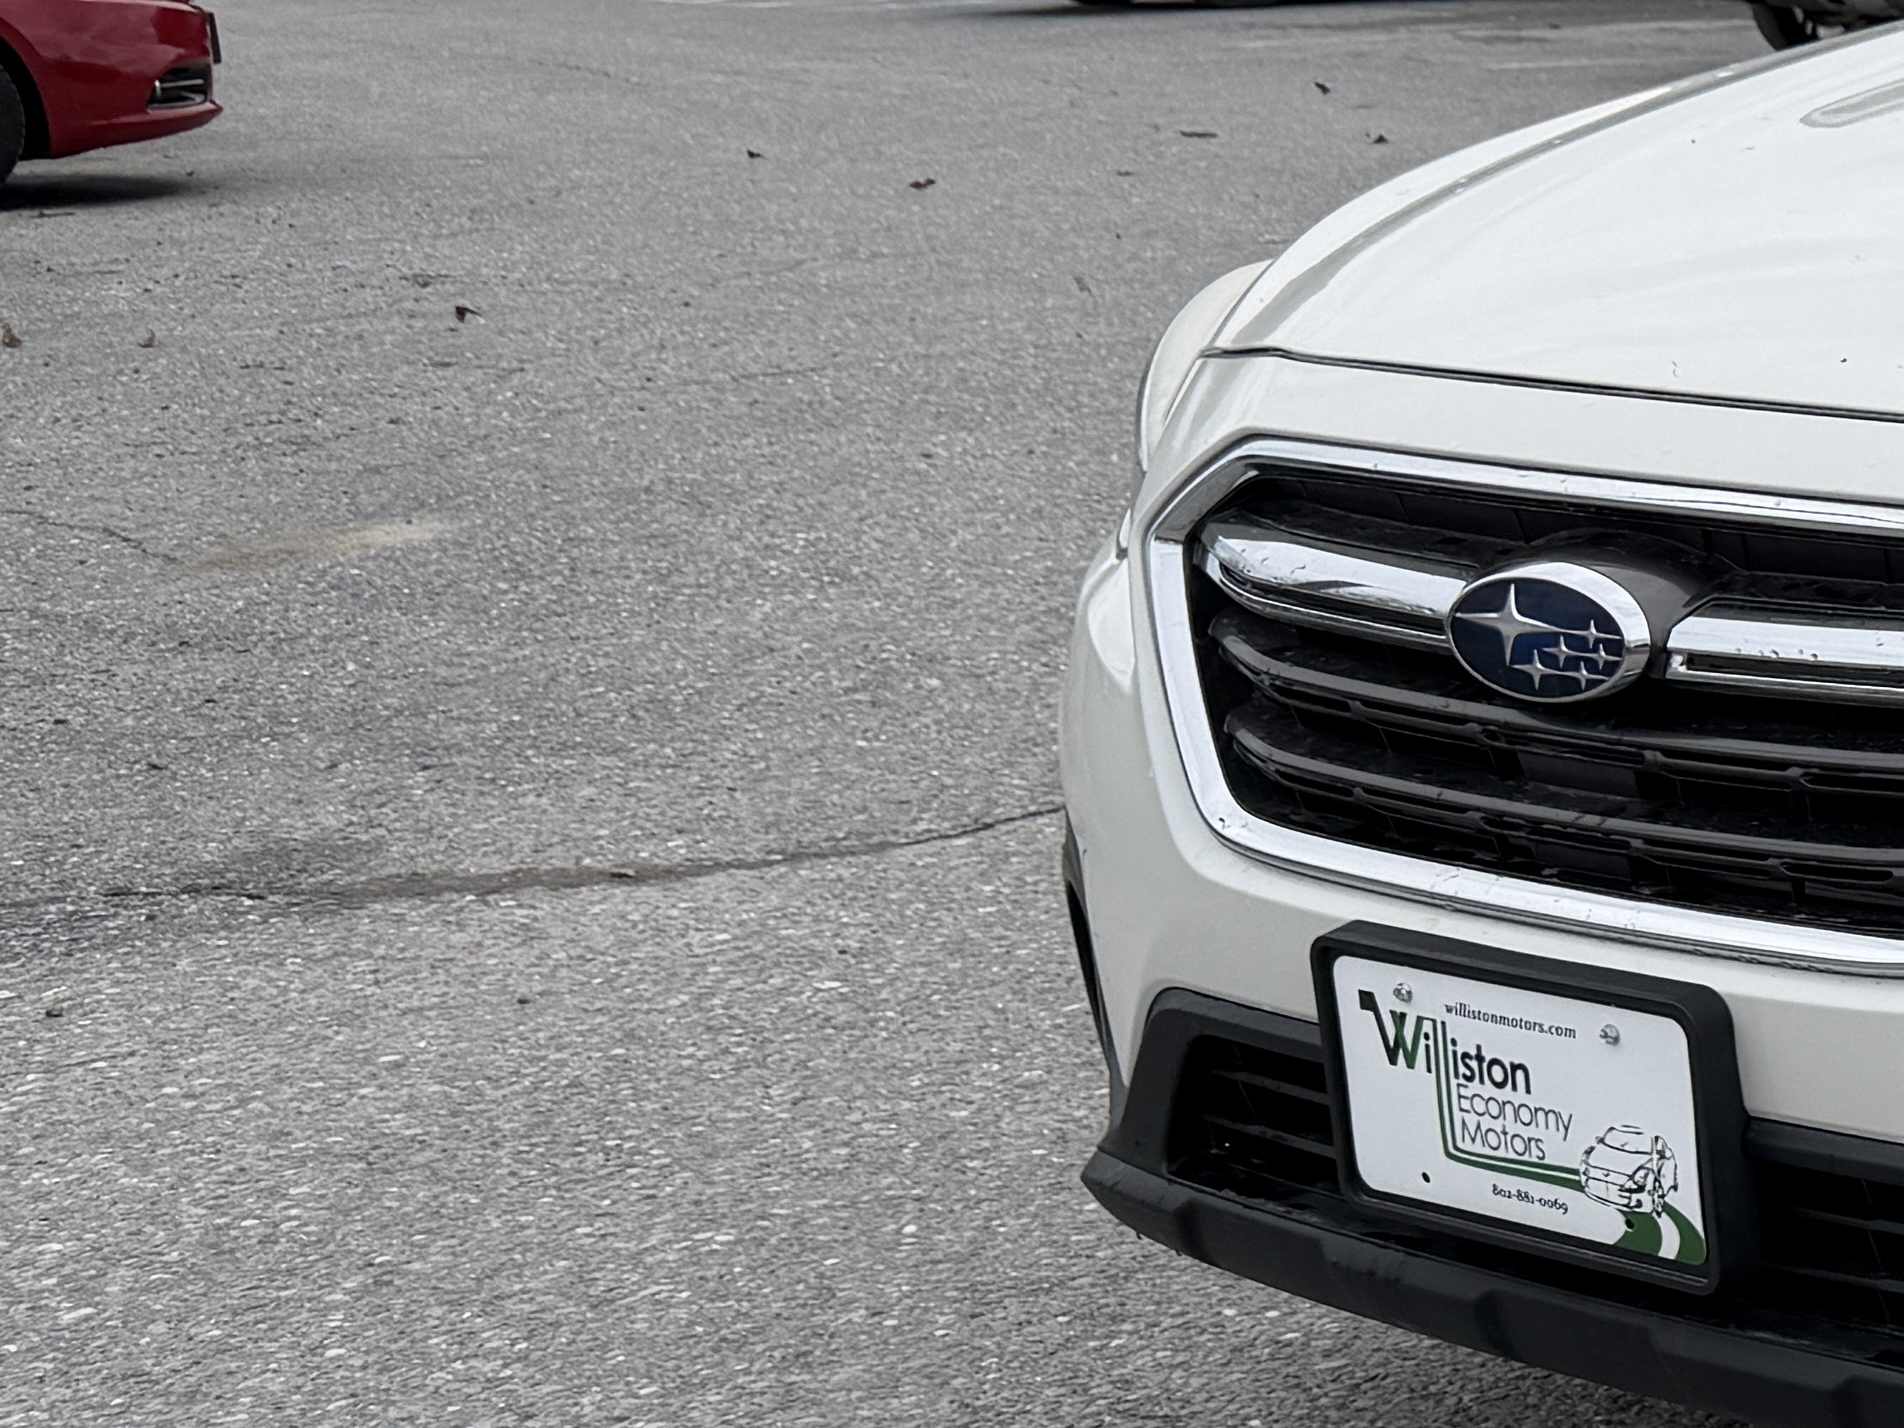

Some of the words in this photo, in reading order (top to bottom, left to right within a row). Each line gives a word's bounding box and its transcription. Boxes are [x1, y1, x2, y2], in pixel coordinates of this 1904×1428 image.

[1357, 988, 1532, 1095] Williston
[1443, 1002, 1577, 1039] willistonmotors.com
[1456, 1082, 1573, 1142] Economy
[1460, 1117, 1546, 1161] Motors
